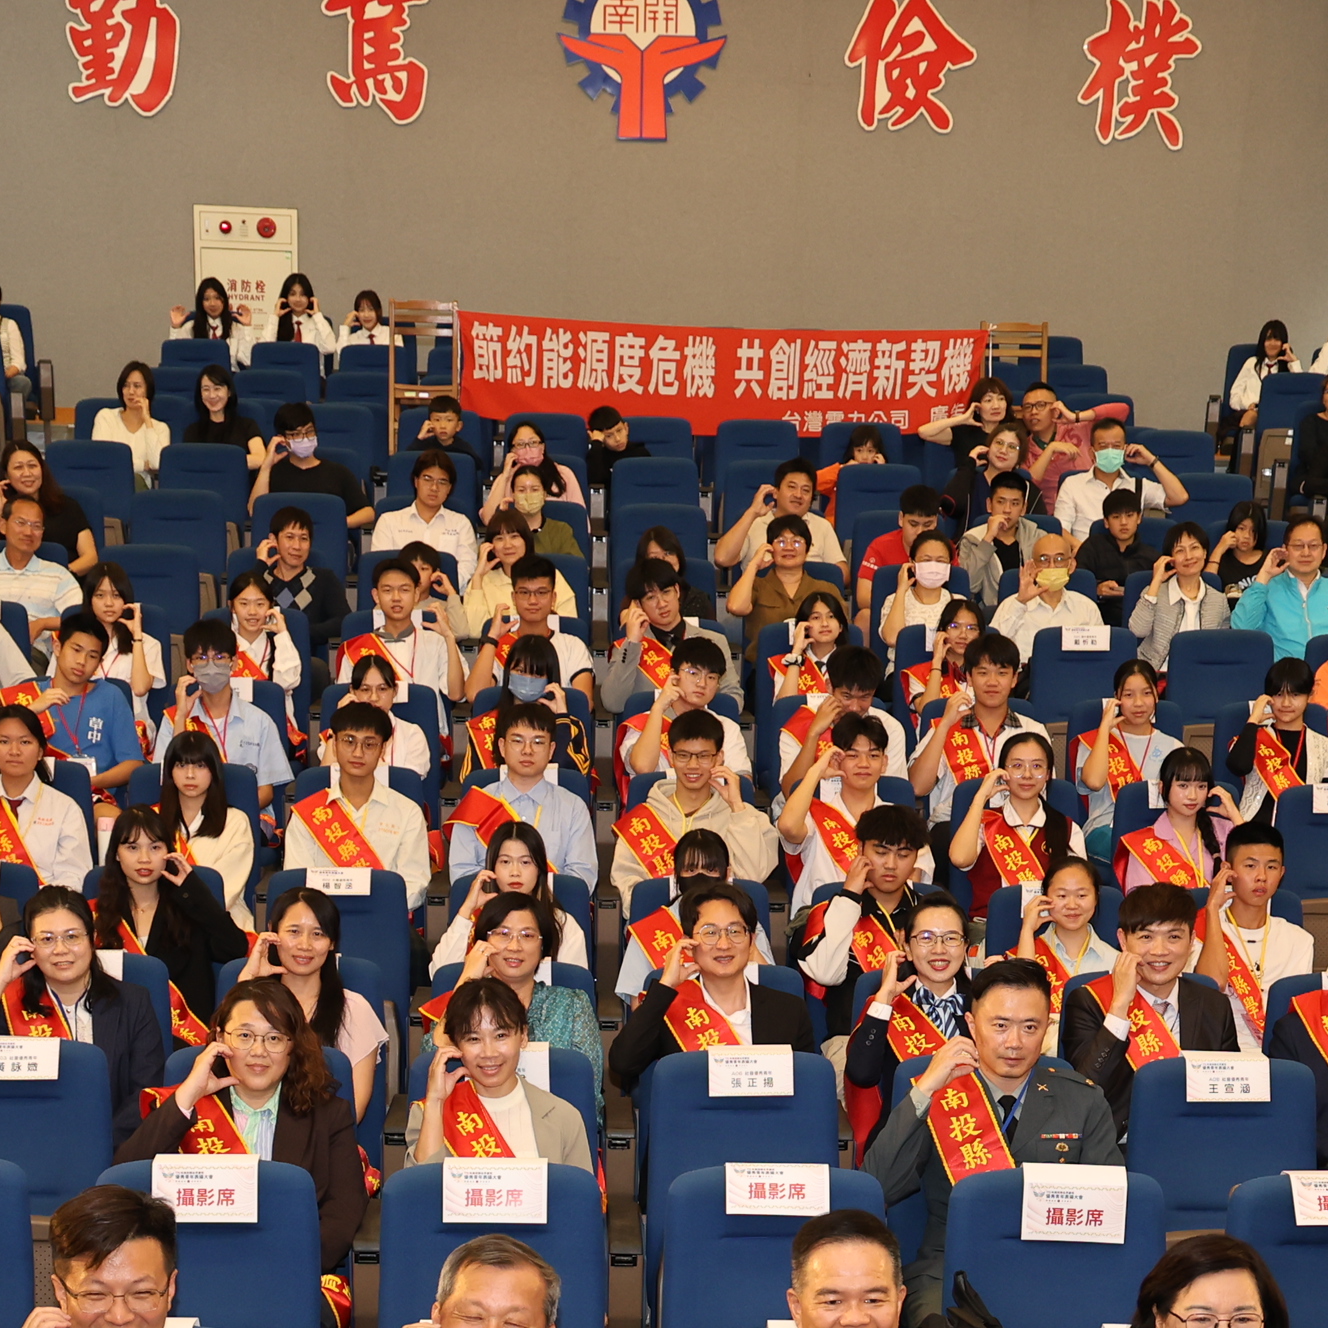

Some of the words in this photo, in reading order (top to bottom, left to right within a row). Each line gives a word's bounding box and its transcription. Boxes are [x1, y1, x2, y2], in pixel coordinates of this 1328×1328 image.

[227, 279, 266, 294] 消防栓
[471, 320, 716, 400] 節約能源度危機
[734, 336, 976, 402] 共創經濟新契機
[782, 410, 910, 432] 台灣電力公司
[1258, 742, 1291, 791] 南投縣
[939, 1088, 994, 1171] 南投縣
[176, 1188, 236, 1208] 攝影席
[464, 1188, 524, 1208] 攝影席
[748, 1182, 807, 1201] 攝影席
[1045, 1207, 1104, 1228] 攝影席
